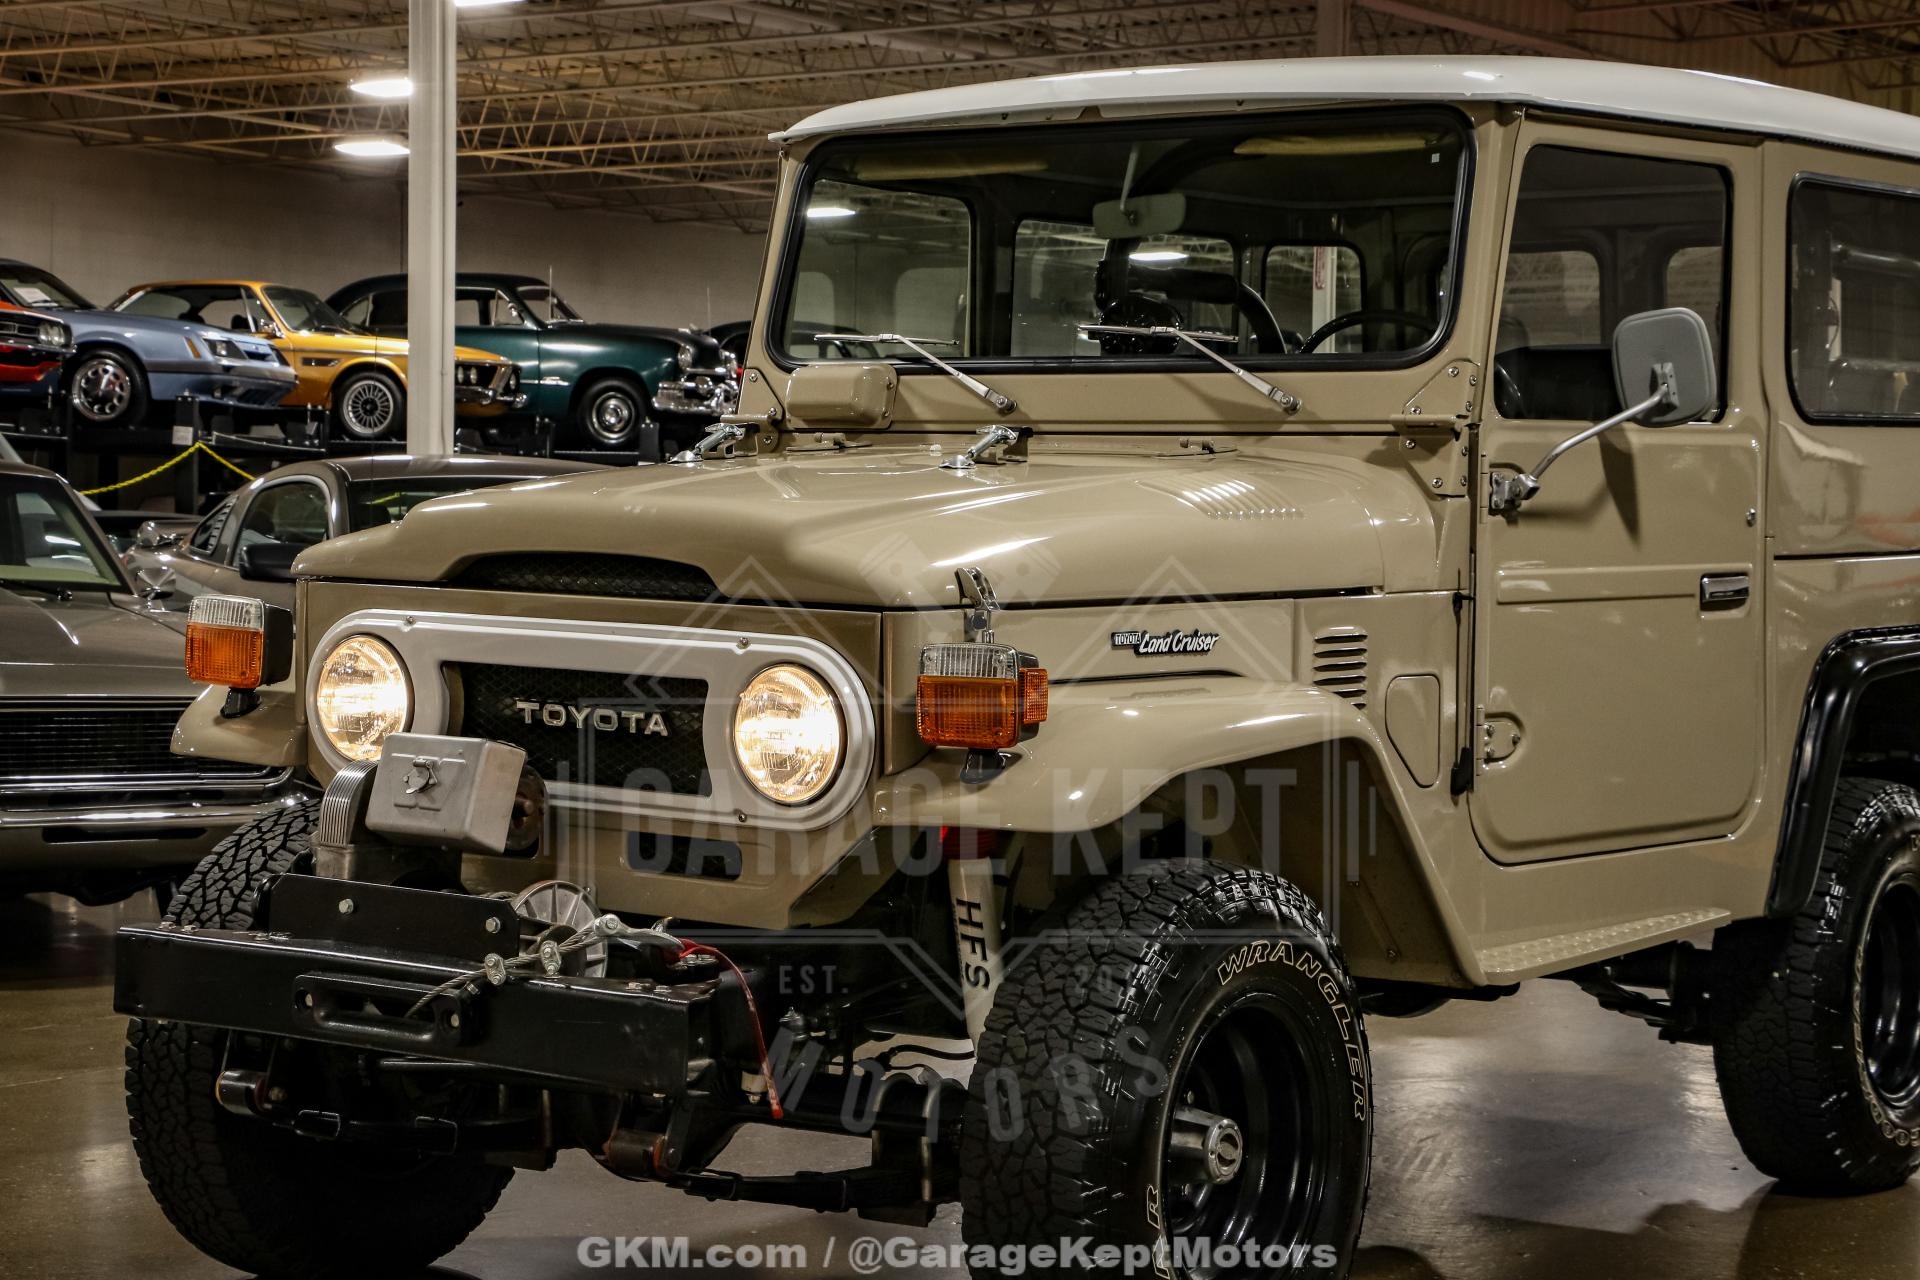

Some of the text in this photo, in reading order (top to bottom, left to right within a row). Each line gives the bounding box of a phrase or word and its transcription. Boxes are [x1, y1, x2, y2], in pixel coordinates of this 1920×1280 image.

[1114, 630, 1221, 654] TOYOTA Land Cruiser
[515, 700, 669, 737] TOYOTA
[956, 898, 991, 989] HFS
[1216, 939, 1367, 1121] WRANGLER
